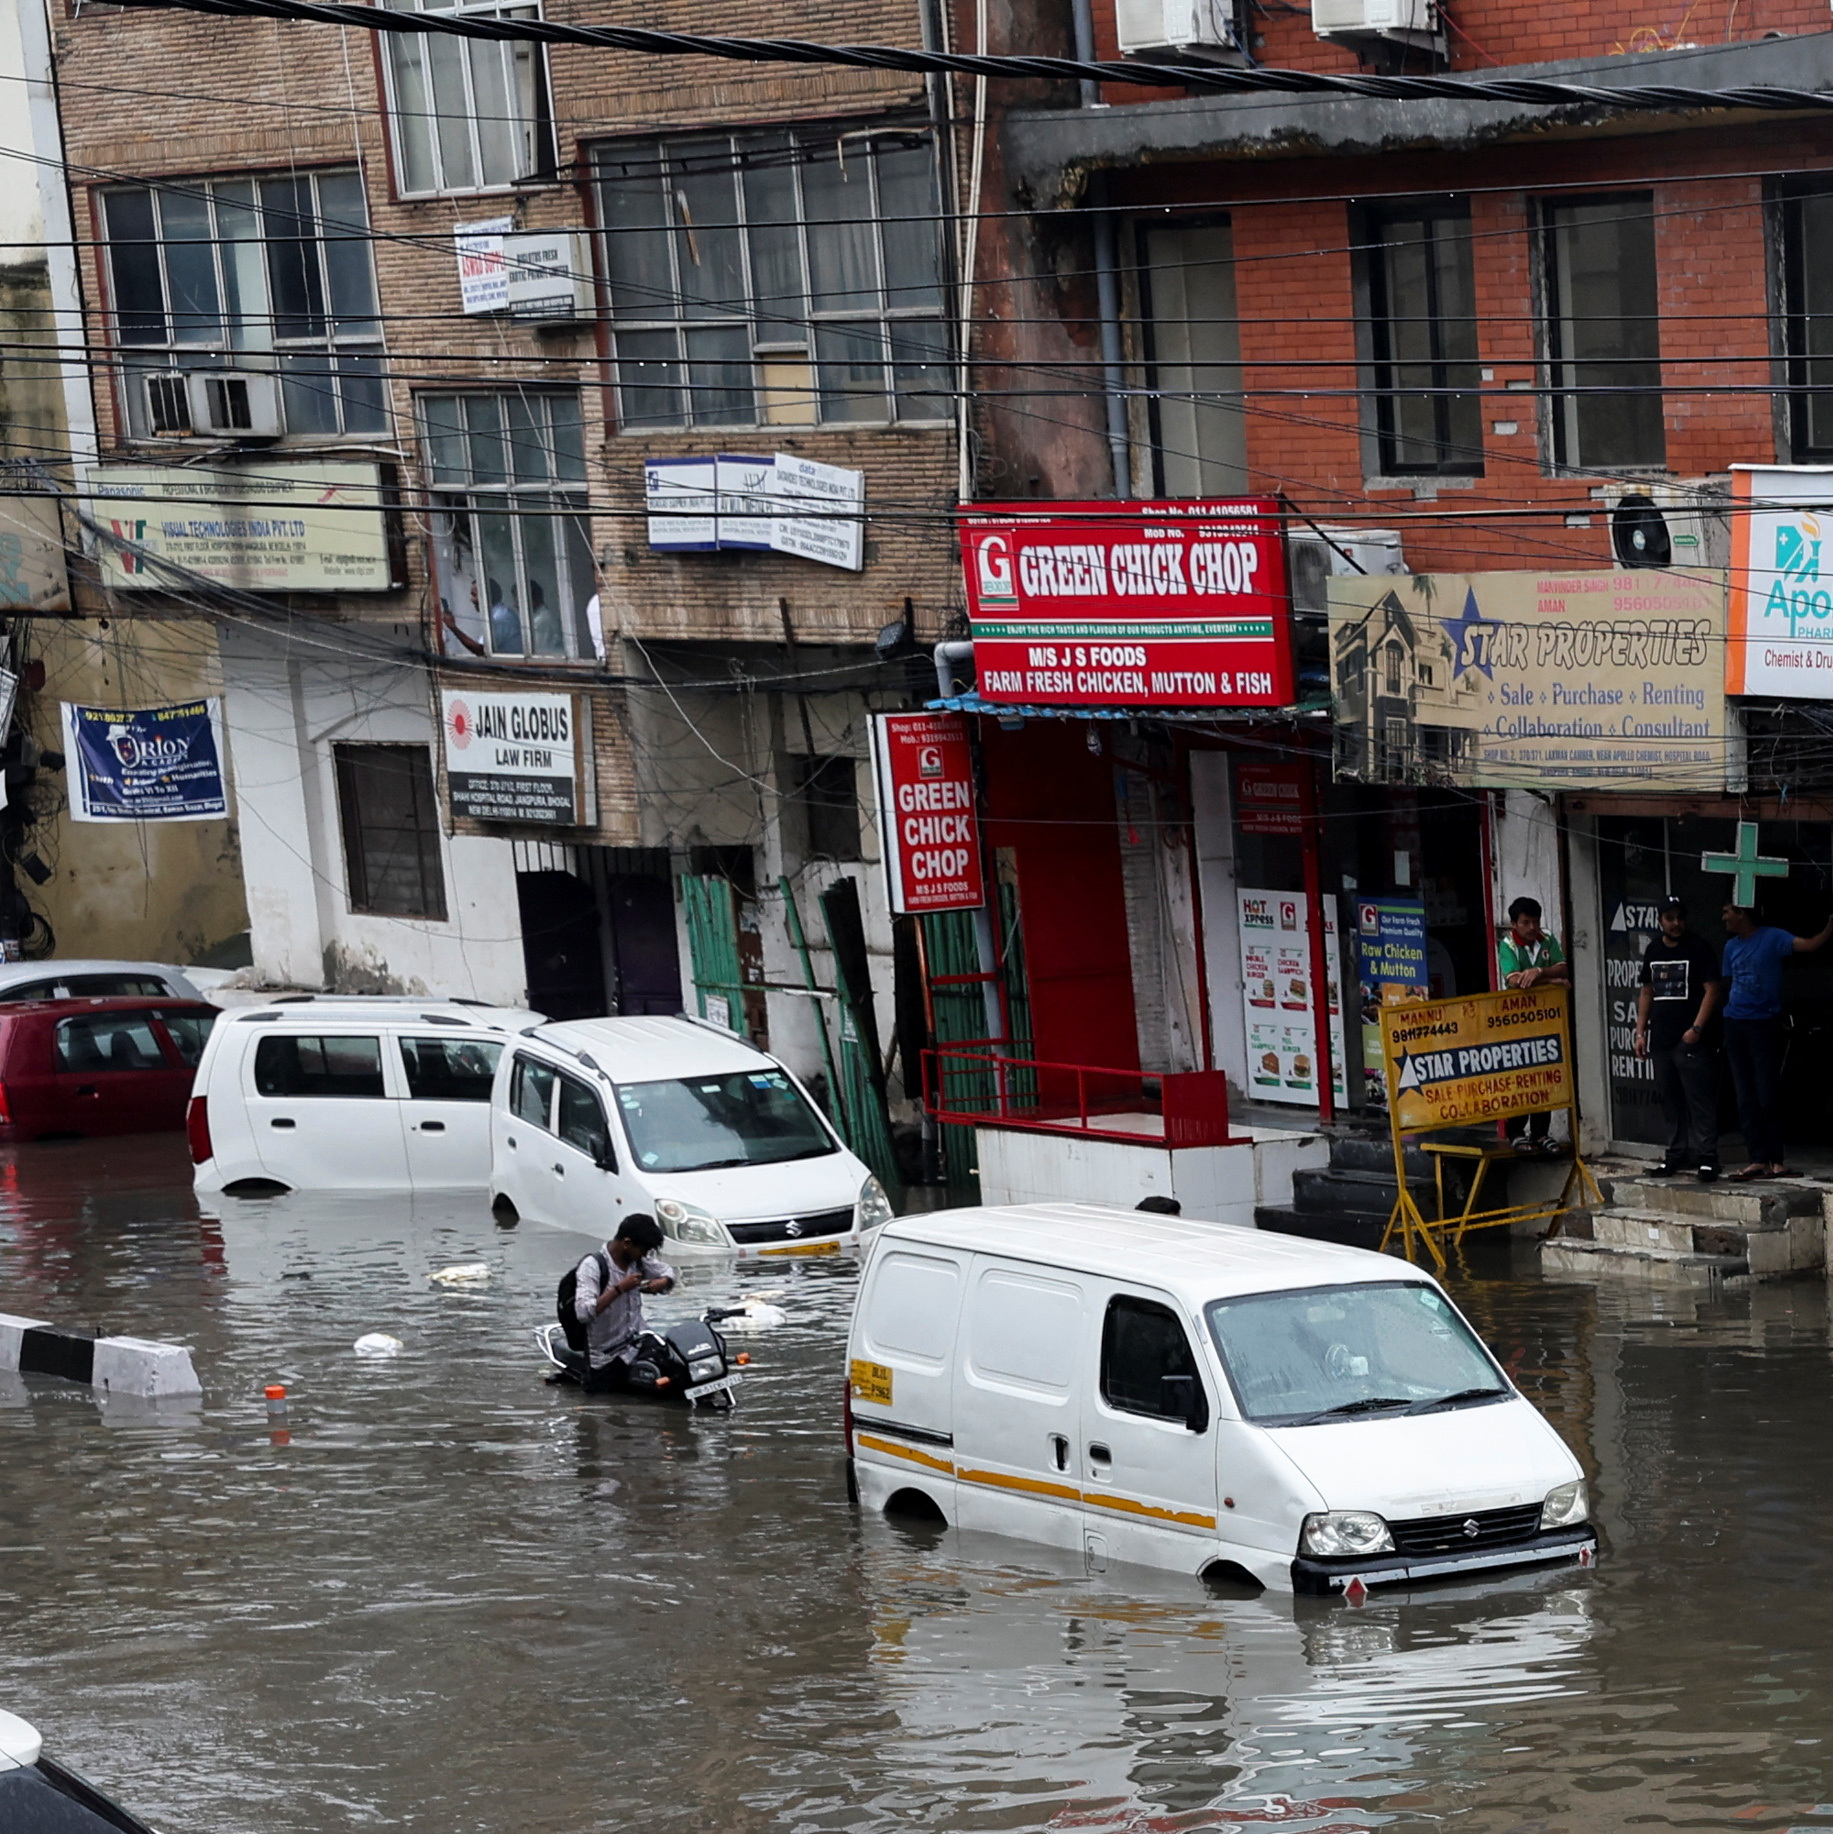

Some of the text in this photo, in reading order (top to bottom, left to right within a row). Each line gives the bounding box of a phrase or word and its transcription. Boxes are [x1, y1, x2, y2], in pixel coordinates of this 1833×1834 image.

[98, 485, 145, 496] Panasonic
[1020, 541, 1258, 597] GREEN CHICK CHOP
[1538, 600, 1566, 613] AMAN
[1007, 624, 1237, 635] ENJOY THE RICH TASTE AND FLAVOUR OF OUR PRODUCTS EVERYDAY
[1461, 619, 1712, 670] STAR PROPERTIES
[1028, 647, 1147, 667] M/S J S FOODS
[1764, 649, 1803, 668] Chemist
[1805, 652, 1812, 667] &
[984, 671, 1272, 697] FARM FRESH CHICKEN, MUTTON & FISH
[1500, 682, 1705, 710] Sale Purchase Renting
[476, 705, 569, 742] JAIN GLOBUS
[1496, 715, 1710, 738] Collaboration Consultant
[495, 749, 552, 768] LAW FIRM
[899, 780, 970, 812] GREEN
[904, 815, 971, 846] CHICK
[912, 849, 969, 879] CHOP
[943, 881, 968, 893] FOODS
[1243, 899, 1267, 914] HOT
[1381, 916, 1391, 924] Our
[1404, 927, 1423, 938] Quality
[1361, 943, 1423, 960] Raw Chicken
[1371, 960, 1415, 977] & Mutton
[1487, 1008, 1561, 1028] 9560505101
[1415, 1038, 1559, 1083] STAR PROPERTIES
[1440, 1091, 1550, 1120] COLLABORATION
